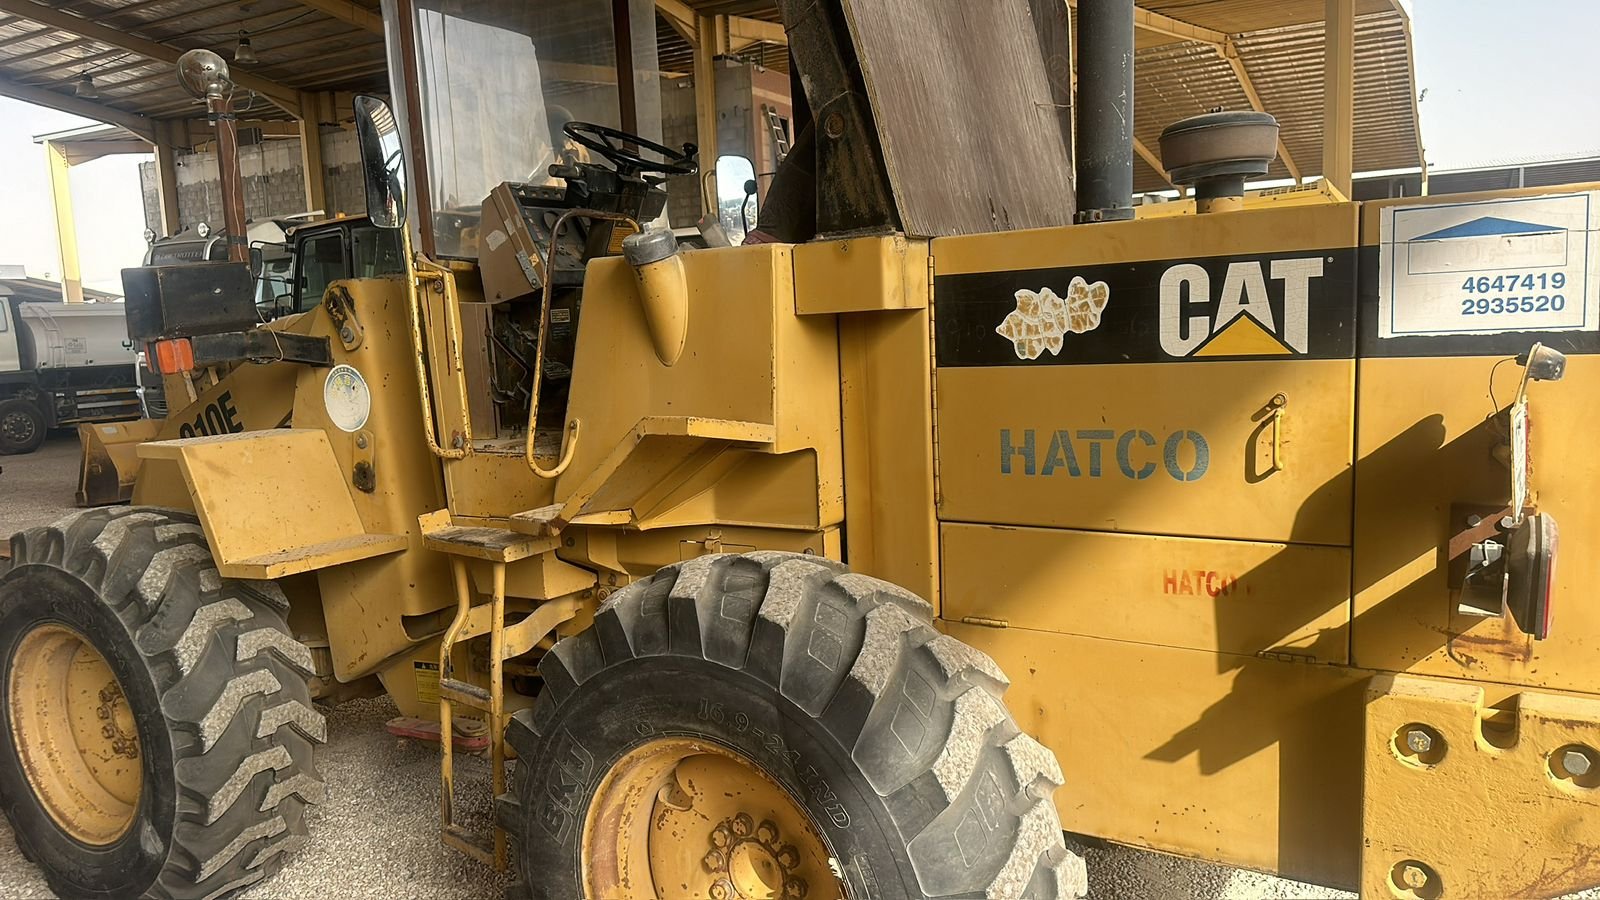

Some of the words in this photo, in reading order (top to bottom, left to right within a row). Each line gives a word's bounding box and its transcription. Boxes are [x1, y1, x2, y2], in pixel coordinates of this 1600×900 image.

[1159, 257, 1324, 357] CAT
[1461, 272, 1566, 294] 4647419
[1461, 294, 1566, 316] 2935520
[1000, 429, 1210, 482] HATCO
[698, 698, 801, 768] 16.9-24
[539, 722, 594, 847] BKT
